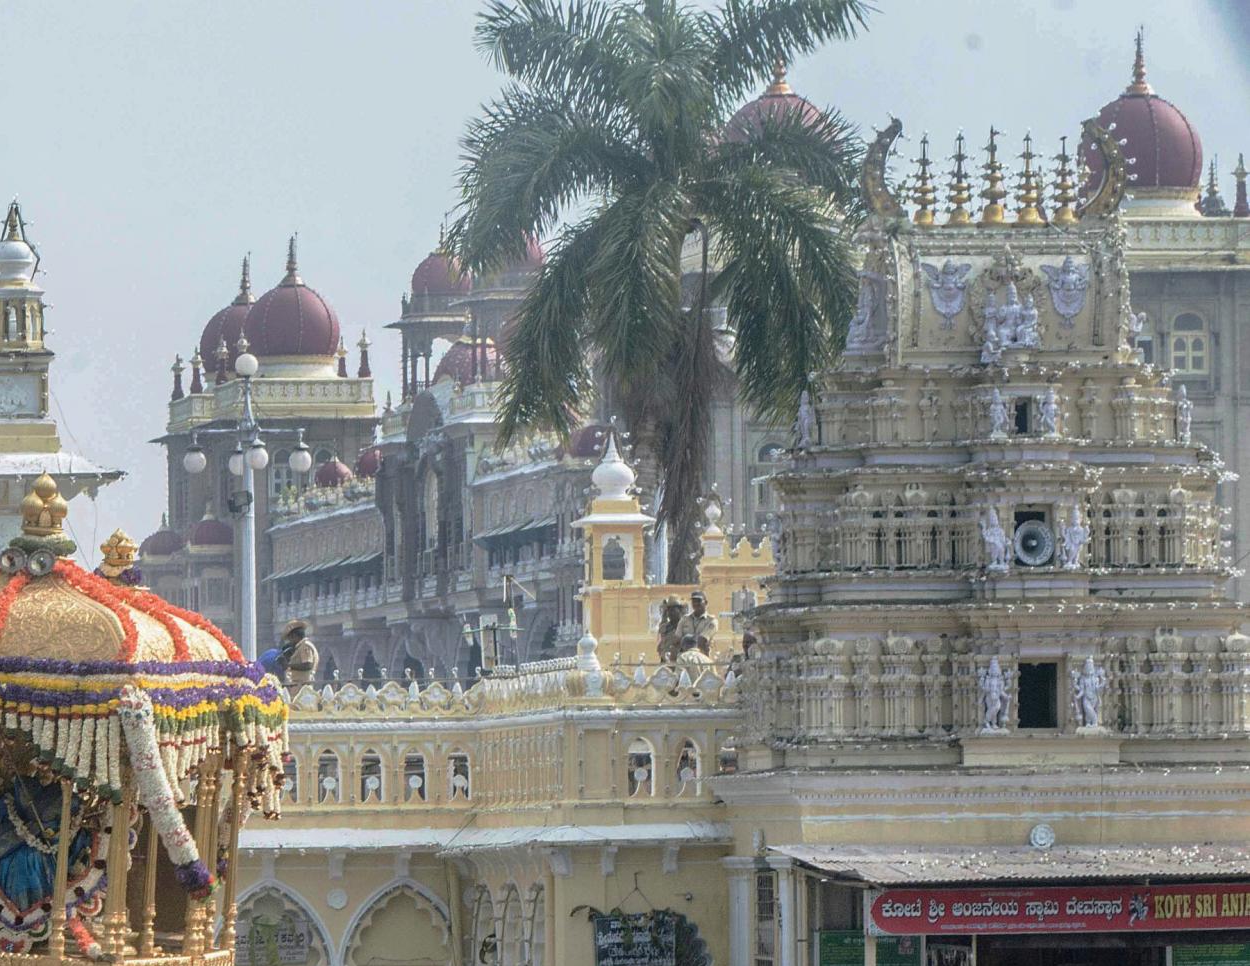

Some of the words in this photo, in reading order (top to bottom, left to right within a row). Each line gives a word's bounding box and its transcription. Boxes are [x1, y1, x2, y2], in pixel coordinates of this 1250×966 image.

[928, 898, 946, 924] ಶ್ರೀ
[1154, 894, 1191, 919] KOTE
[1195, 893, 1217, 918] SRI
